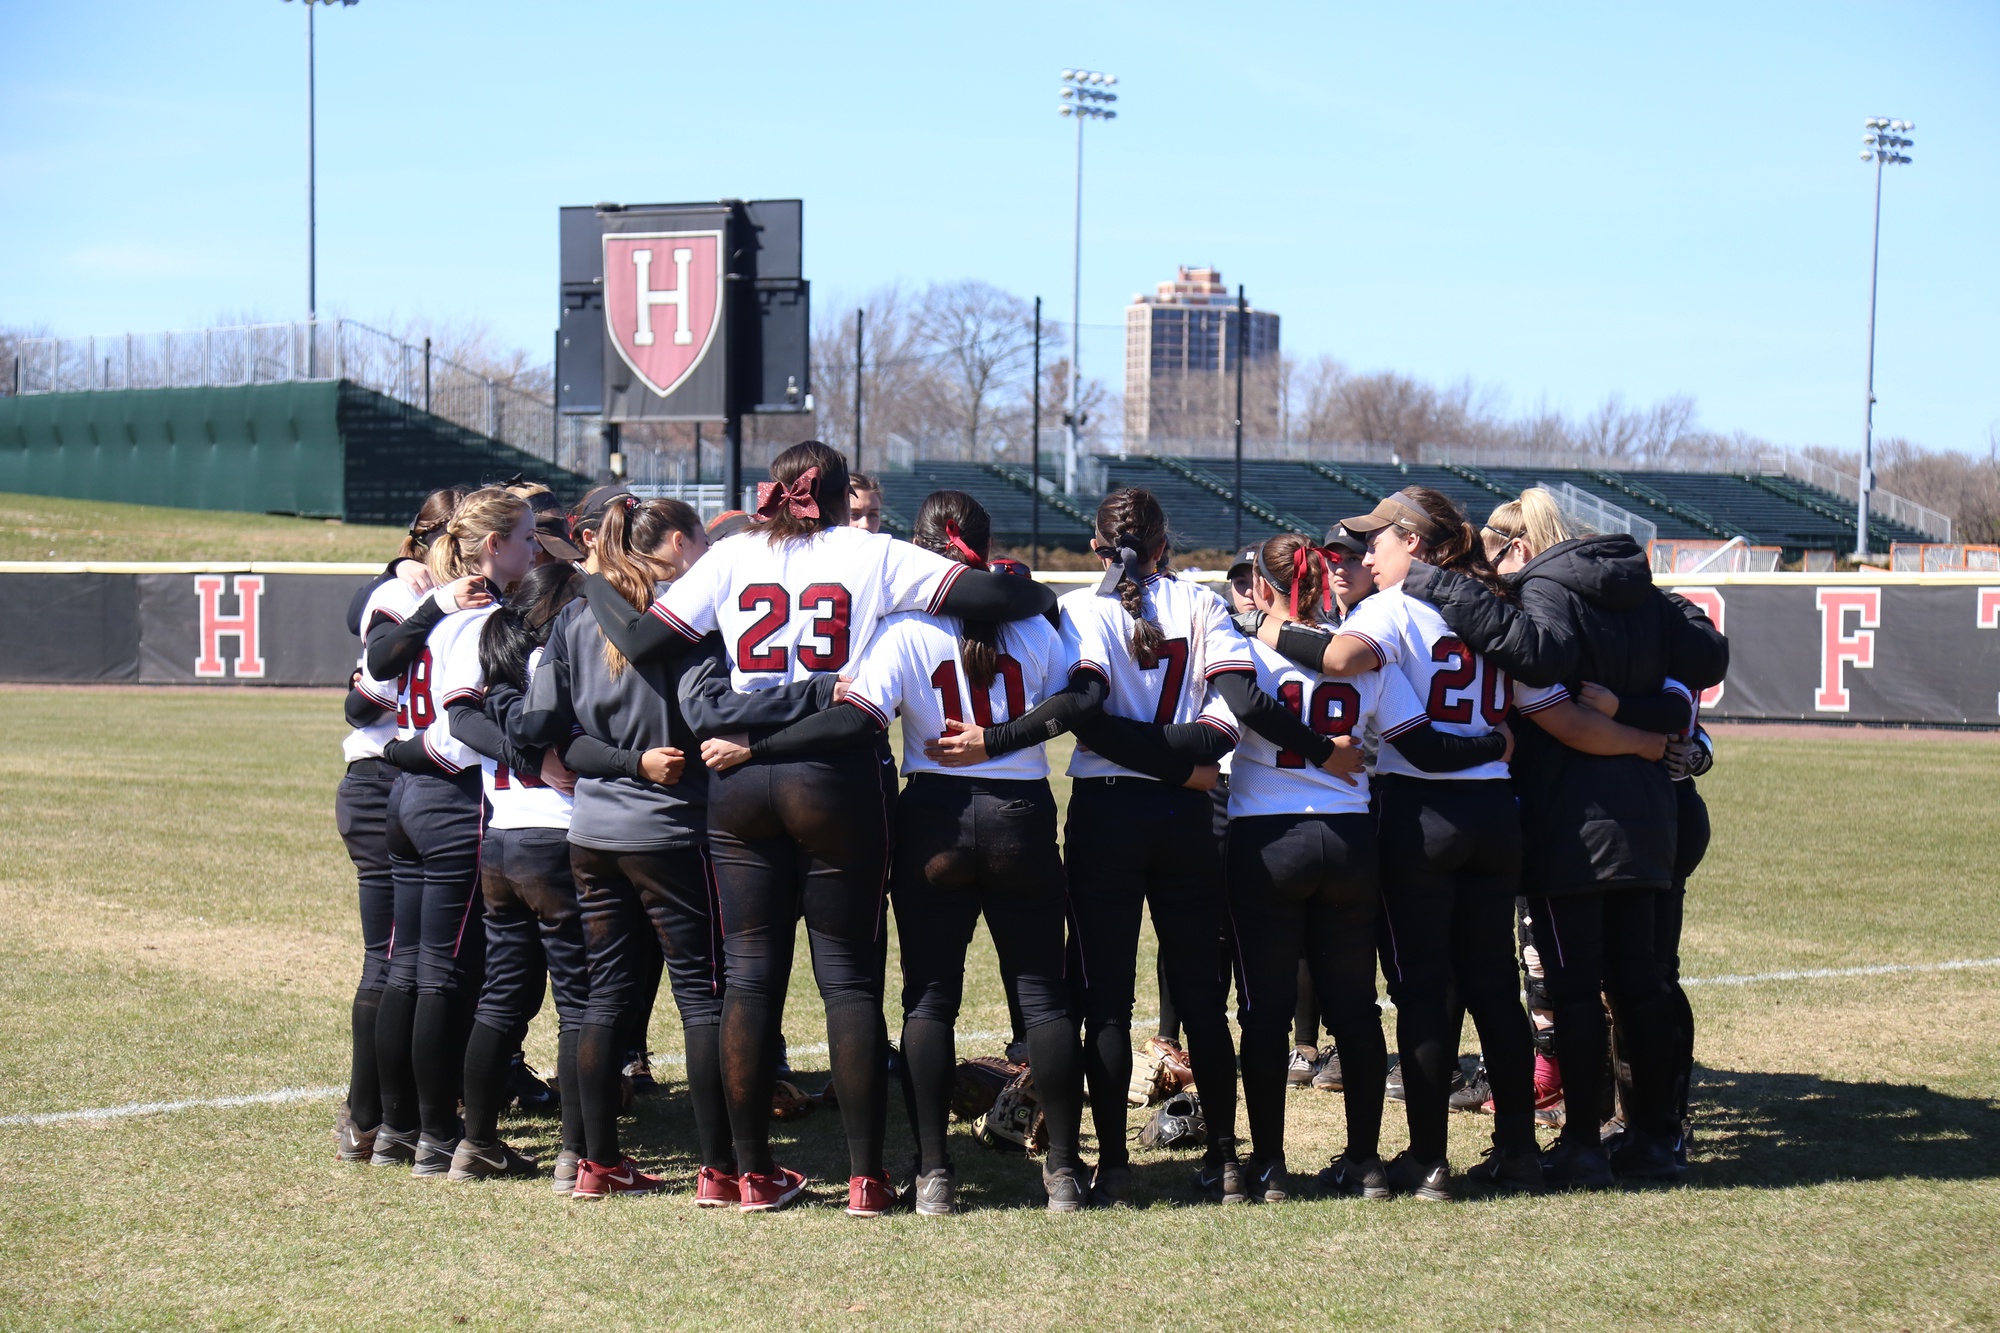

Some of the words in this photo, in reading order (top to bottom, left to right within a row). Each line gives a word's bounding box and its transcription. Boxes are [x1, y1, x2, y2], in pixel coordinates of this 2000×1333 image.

[632, 248, 693, 346] H
[194, 575, 265, 678] H
[738, 582, 852, 672] 23
[931, 653, 1026, 739] 10
[1139, 638, 1189, 724] 7
[1426, 636, 1514, 726] 20
